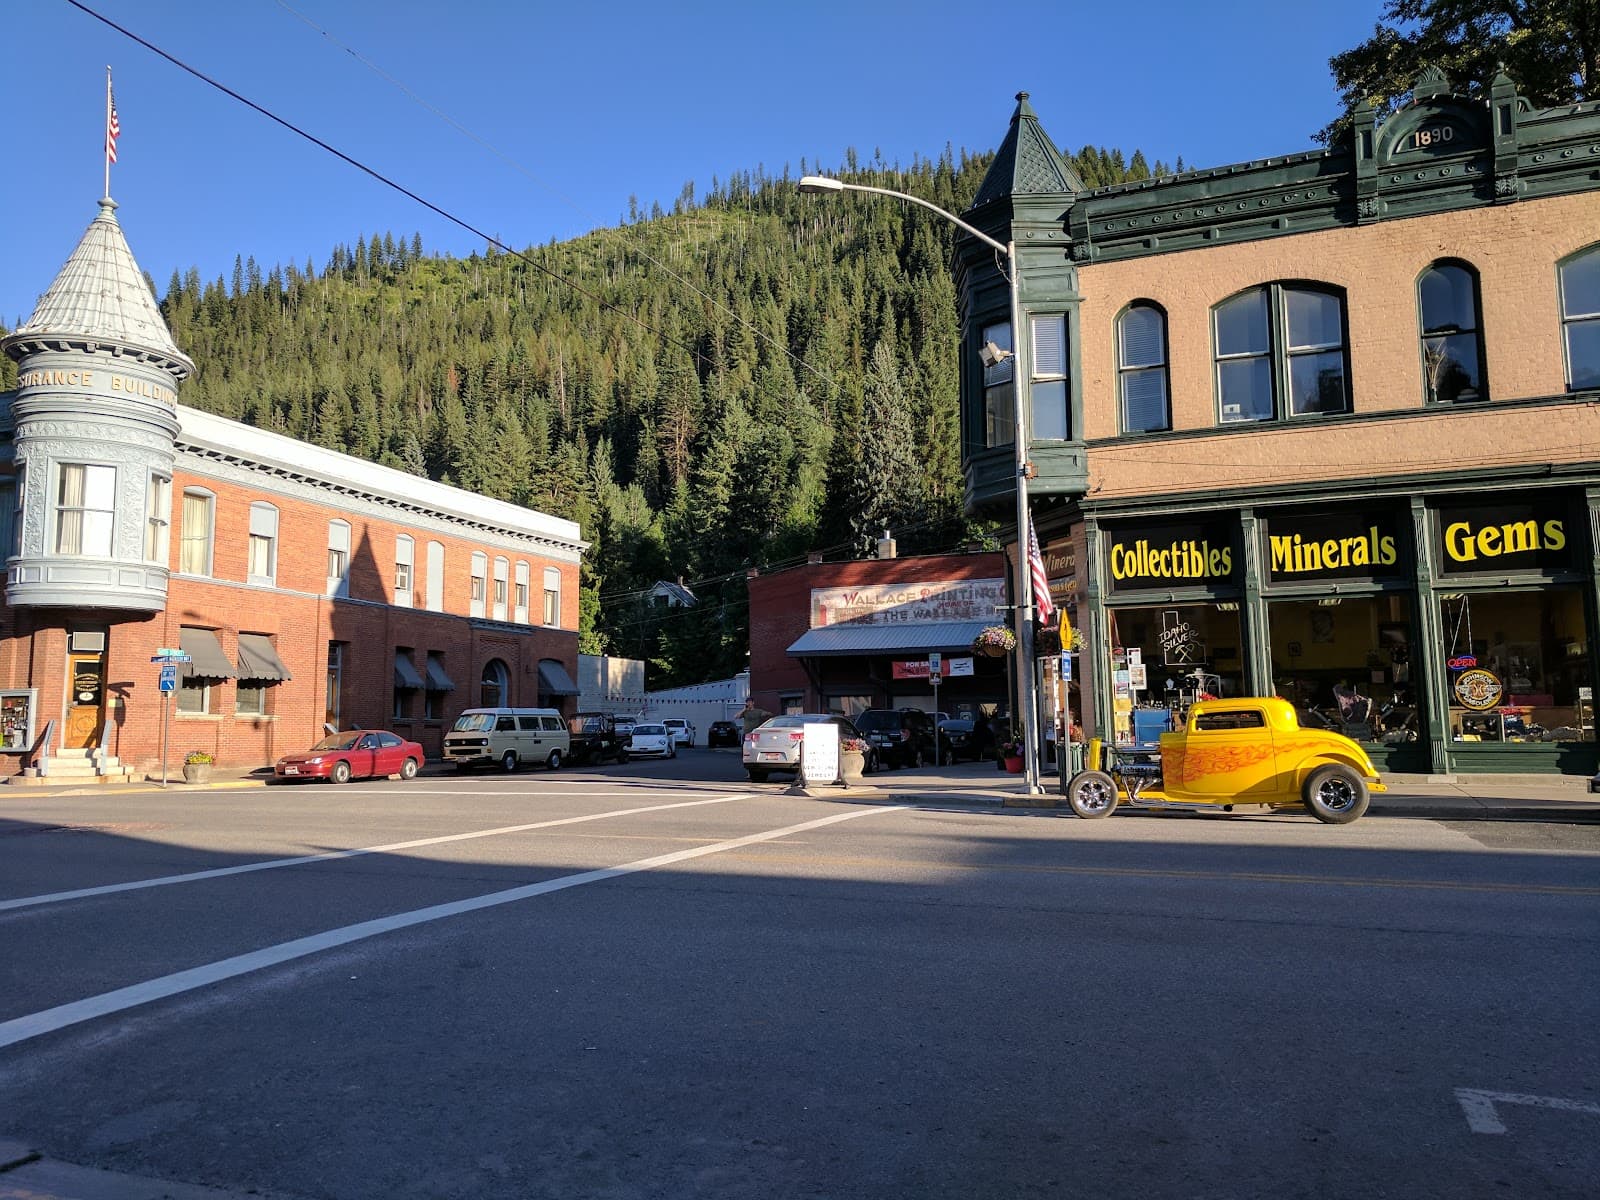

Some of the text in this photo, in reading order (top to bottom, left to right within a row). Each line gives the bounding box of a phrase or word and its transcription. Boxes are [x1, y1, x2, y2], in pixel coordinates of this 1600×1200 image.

[1414, 126, 1454, 147] 1890
[17, 370, 94, 388] SURANCE
[1270, 526, 1397, 572] Minerals
[1445, 519, 1566, 562] Gems
[1111, 540, 1232, 580] Collectibles
[843, 590, 917, 607] WALLACE
[1158, 622, 1190, 644] IDAHO
[1163, 630, 1199, 651] SILVER
[1448, 657, 1477, 667] OPEN
[1462, 673, 1494, 685] JOHNSON
